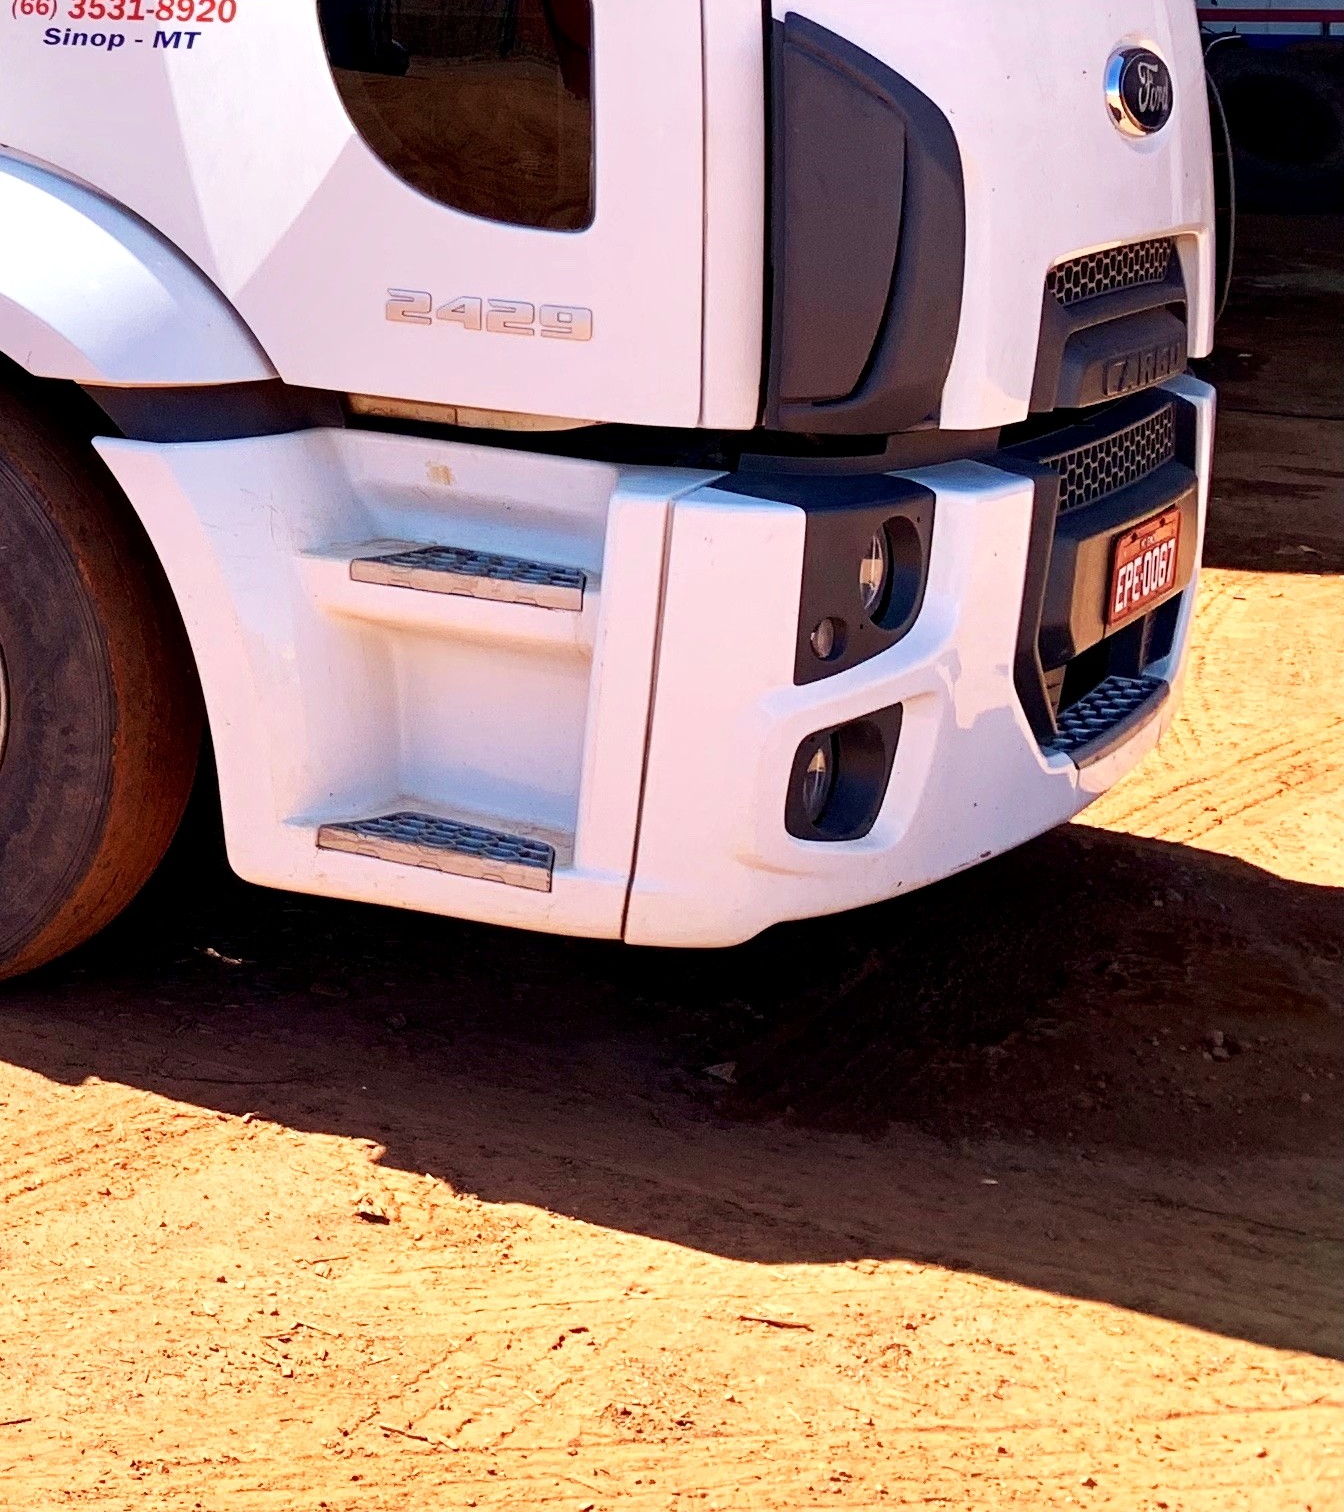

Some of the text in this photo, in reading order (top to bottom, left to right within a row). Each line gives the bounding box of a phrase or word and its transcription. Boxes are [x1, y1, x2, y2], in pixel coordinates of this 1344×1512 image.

[43, 27, 125, 51] Sinop
[152, 31, 201, 50] MT
[386, 288, 593, 341] 2429
[1115, 538, 1176, 613] EPE-0067
